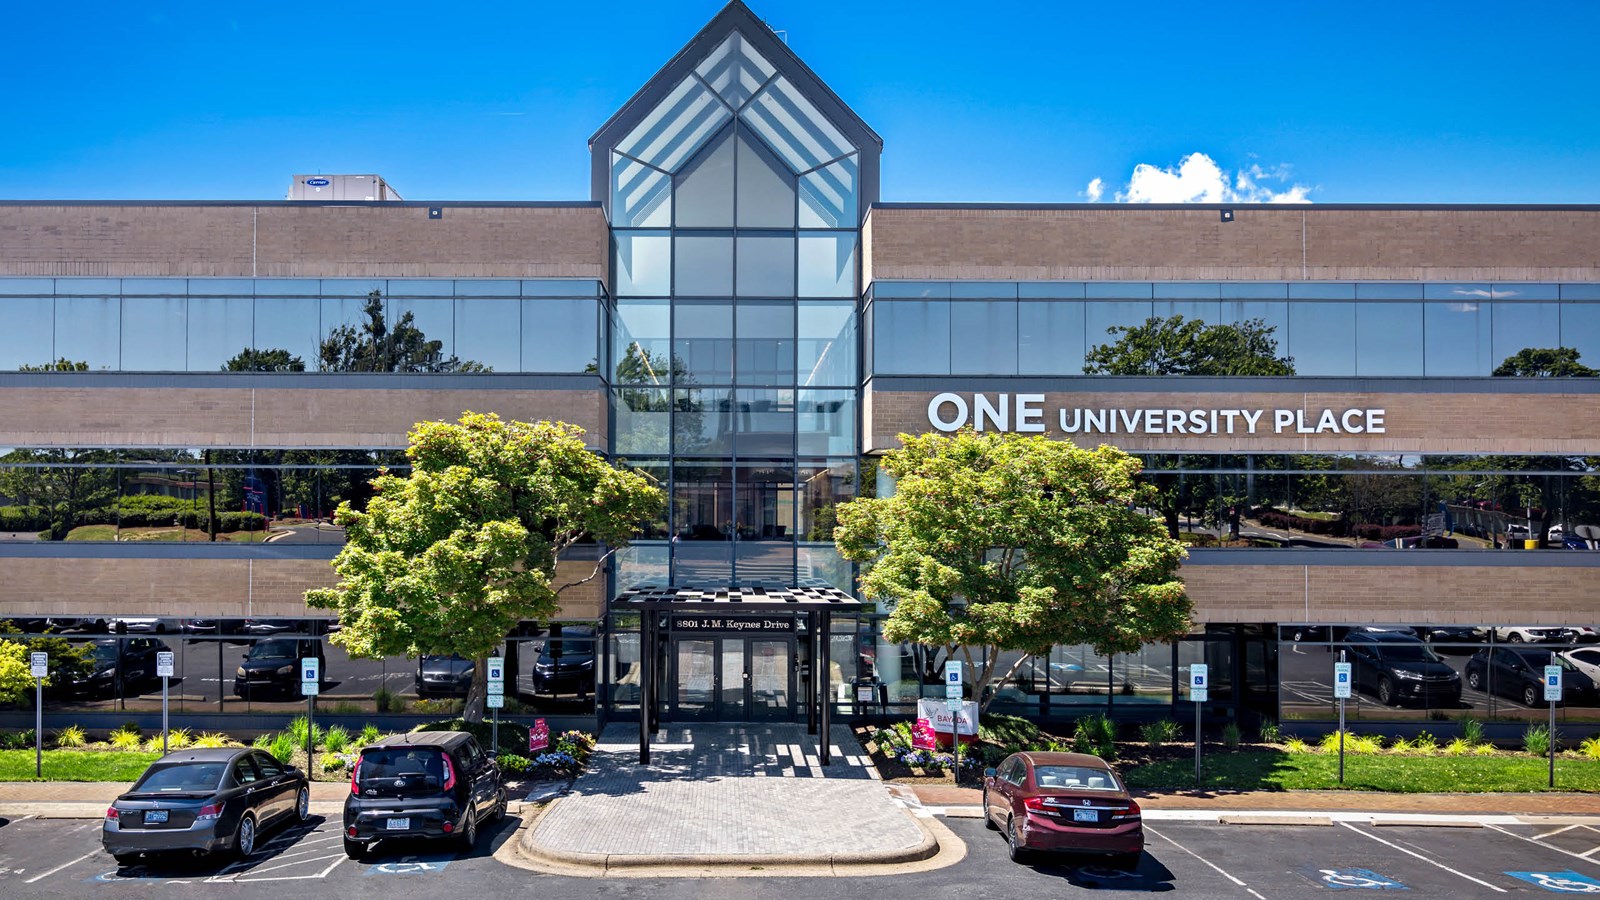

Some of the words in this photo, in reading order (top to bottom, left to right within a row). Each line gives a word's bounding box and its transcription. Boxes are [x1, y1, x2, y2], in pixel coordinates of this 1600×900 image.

[928, 392, 1045, 432] ONE
[1059, 408, 1263, 433] UNIVERSITY
[1275, 409, 1385, 433] PLACE
[676, 620, 698, 628] 8801
[701, 620, 710, 628] J.
[711, 620, 724, 628] M.
[726, 620, 760, 630] Keynes
[763, 620, 790, 628] Drive
